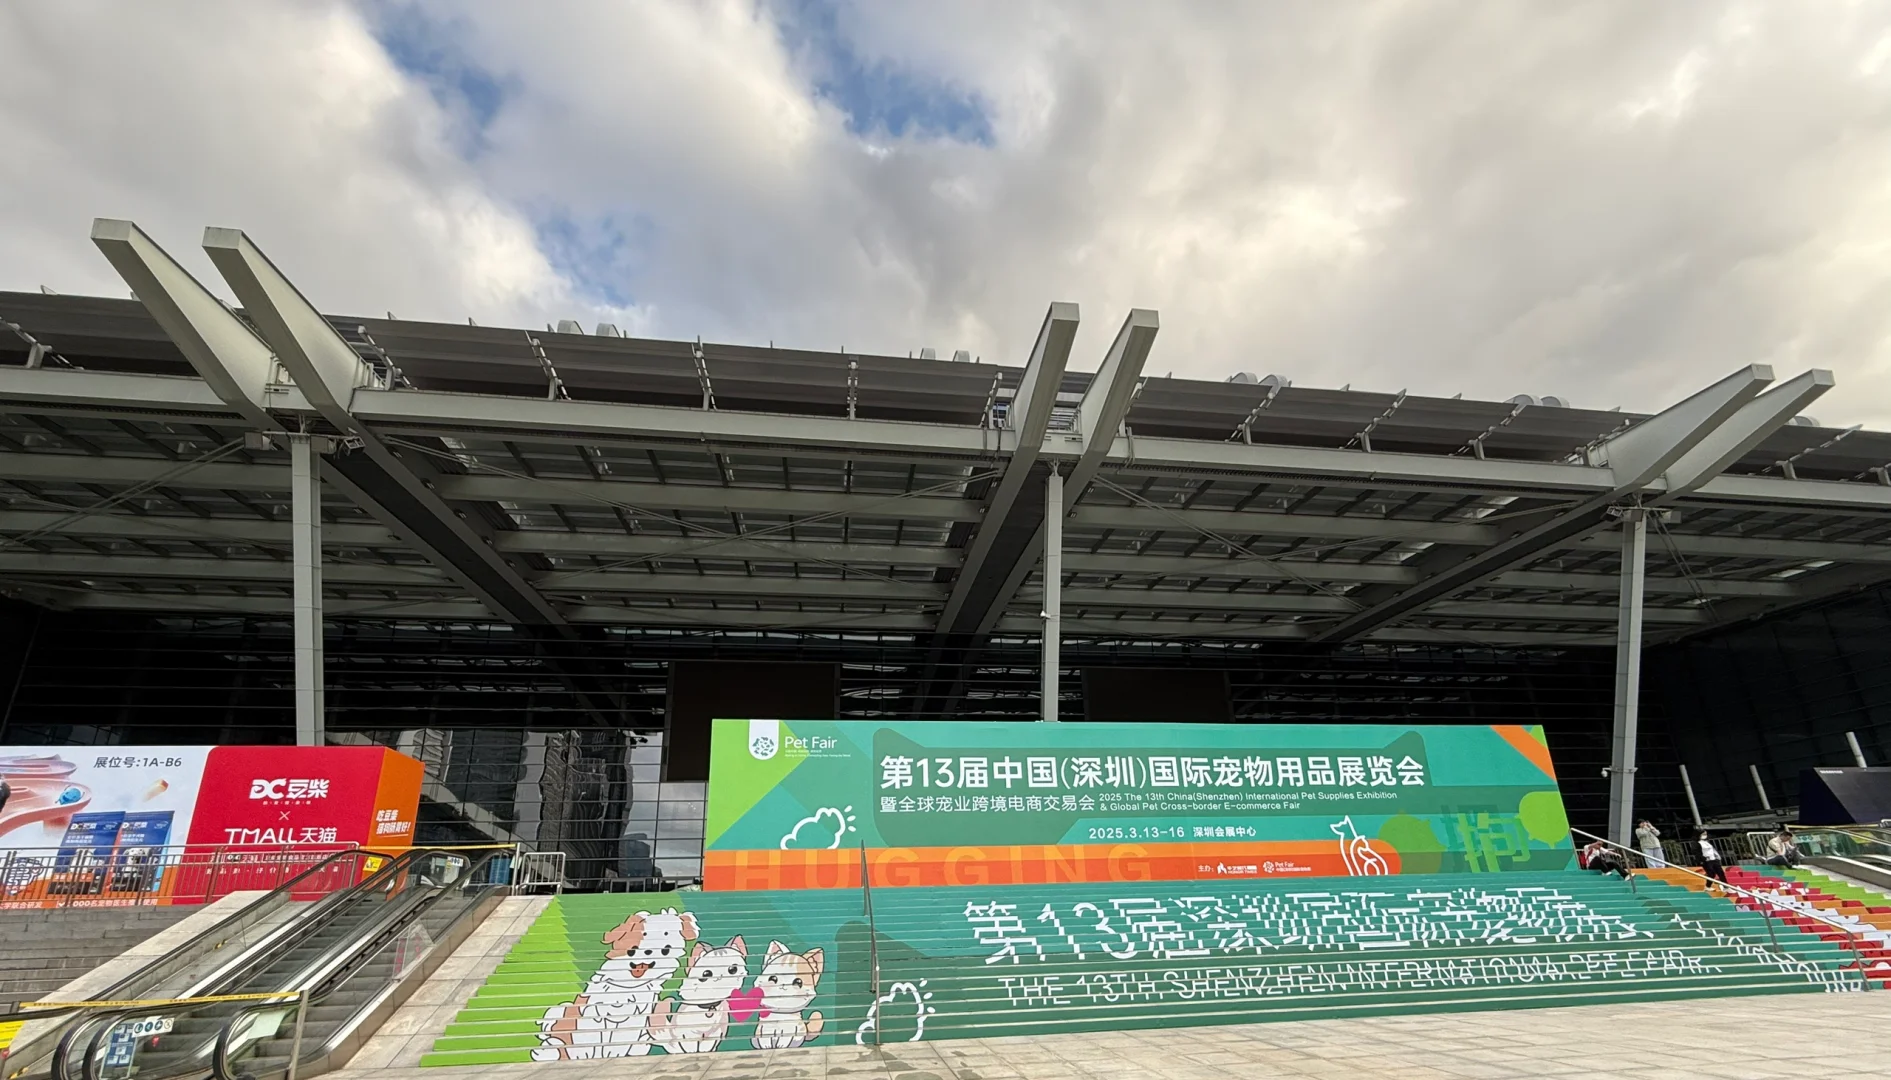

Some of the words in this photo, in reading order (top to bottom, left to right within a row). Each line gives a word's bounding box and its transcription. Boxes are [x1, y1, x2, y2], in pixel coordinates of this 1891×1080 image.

[785, 736, 808, 748] Pet
[812, 736, 837, 748] Fair
[94, 756, 182, 769] 展位号:1A-B6
[880, 755, 1425, 790] 第13届中国(深圳)国际宠物用品展览会
[1099, 793, 1122, 801] 2025
[1124, 793, 1142, 801] The
[1145, 792, 1165, 801] 13th
[1167, 792, 1243, 802] China(Shenzhen)
[1245, 791, 1299, 800] International
[1301, 791, 1316, 800] Pet
[1318, 791, 1355, 802] Supplies
[1357, 790, 1398, 799] Exhibition
[880, 796, 1096, 813] 暨全球宠业跨境电商交易会
[1099, 803, 1107, 811] &
[1110, 803, 1140, 811] Global
[1142, 802, 1158, 811] Pet
[1160, 802, 1221, 810] Cross-border
[1224, 802, 1281, 810] E-commerce
[1283, 801, 1300, 809] Fair
[1089, 826, 1185, 840] 2025.3.13-16
[1192, 825, 1258, 838] 深圳会展中心
[734, 843, 1154, 890] HUGGING
[998, 976, 1071, 1006] THE
[1076, 972, 1164, 1003] 13TH
[1163, 963, 1347, 999] SHENZHEN
[1337, 955, 1591, 992] INTERNATIONAL
[1569, 952, 1636, 979] PET
[1628, 949, 1722, 977] FAIR
